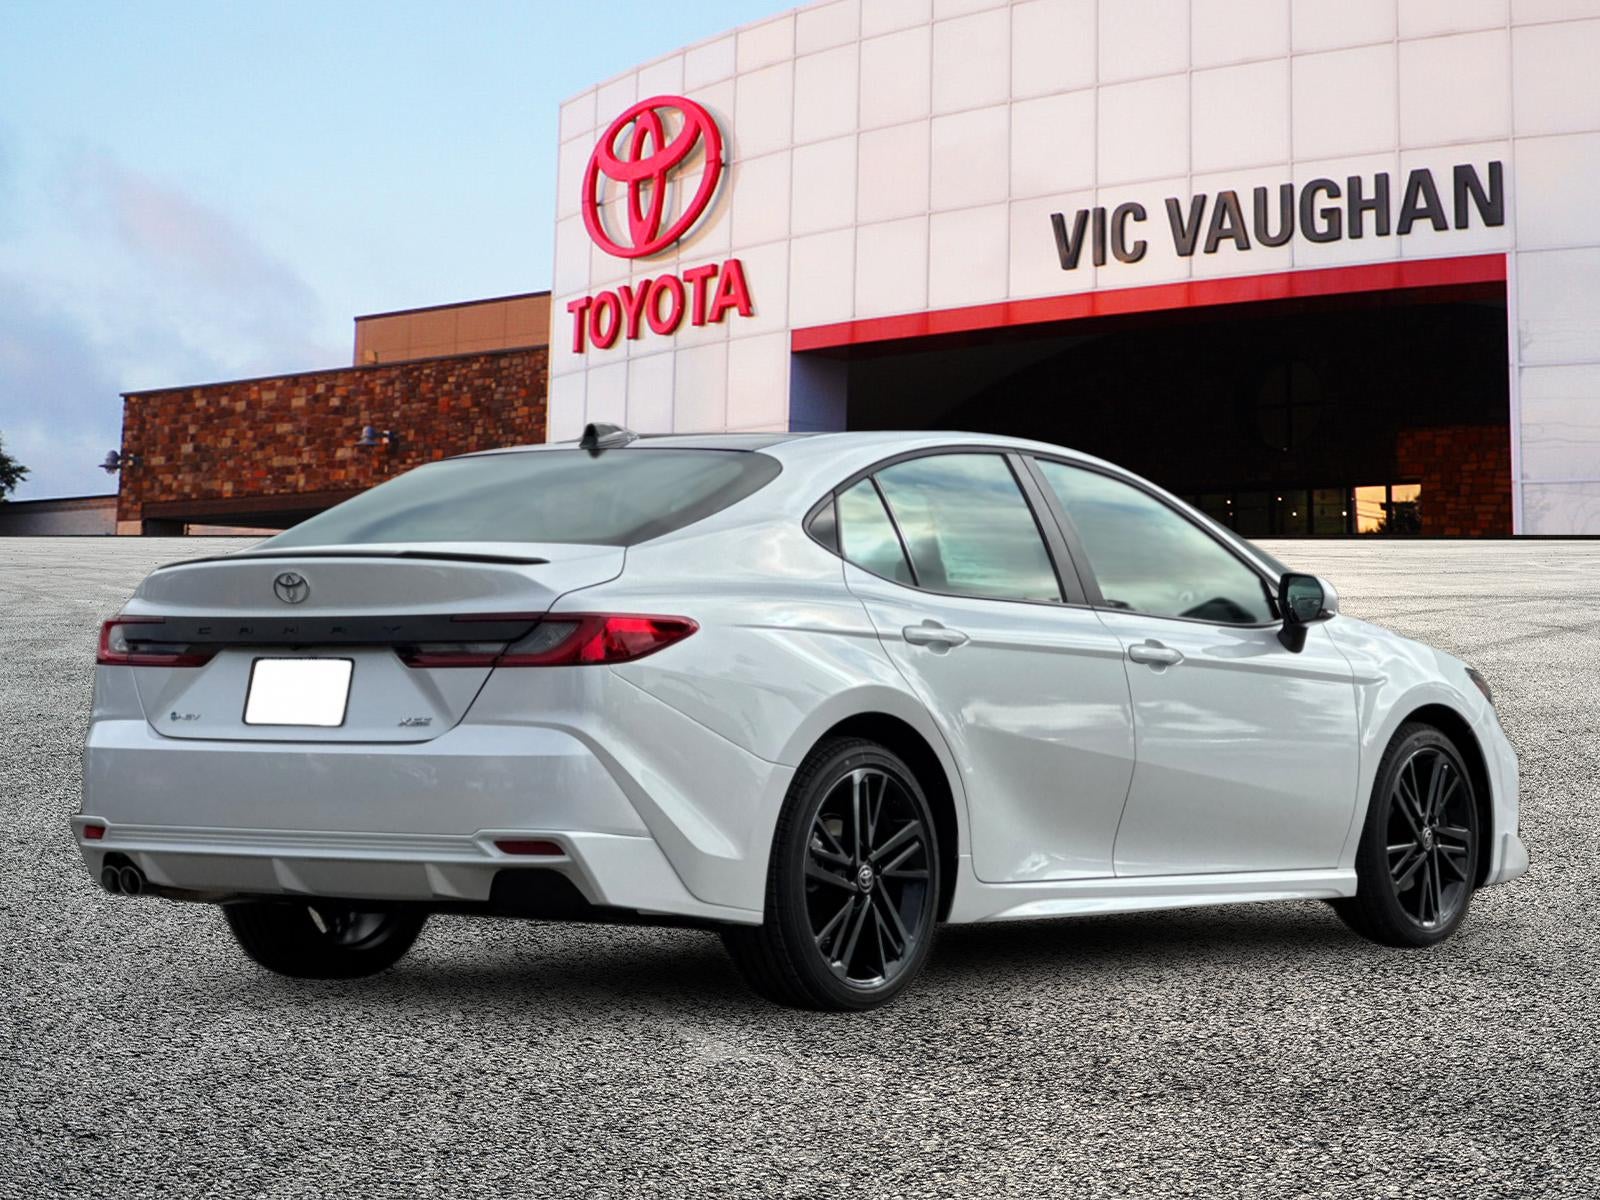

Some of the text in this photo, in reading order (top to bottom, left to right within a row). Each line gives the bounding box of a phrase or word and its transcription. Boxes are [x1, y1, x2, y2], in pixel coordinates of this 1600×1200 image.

[1050, 160, 1505, 270] VIC VAUGHAN
[567, 258, 754, 353] TOYOTA
